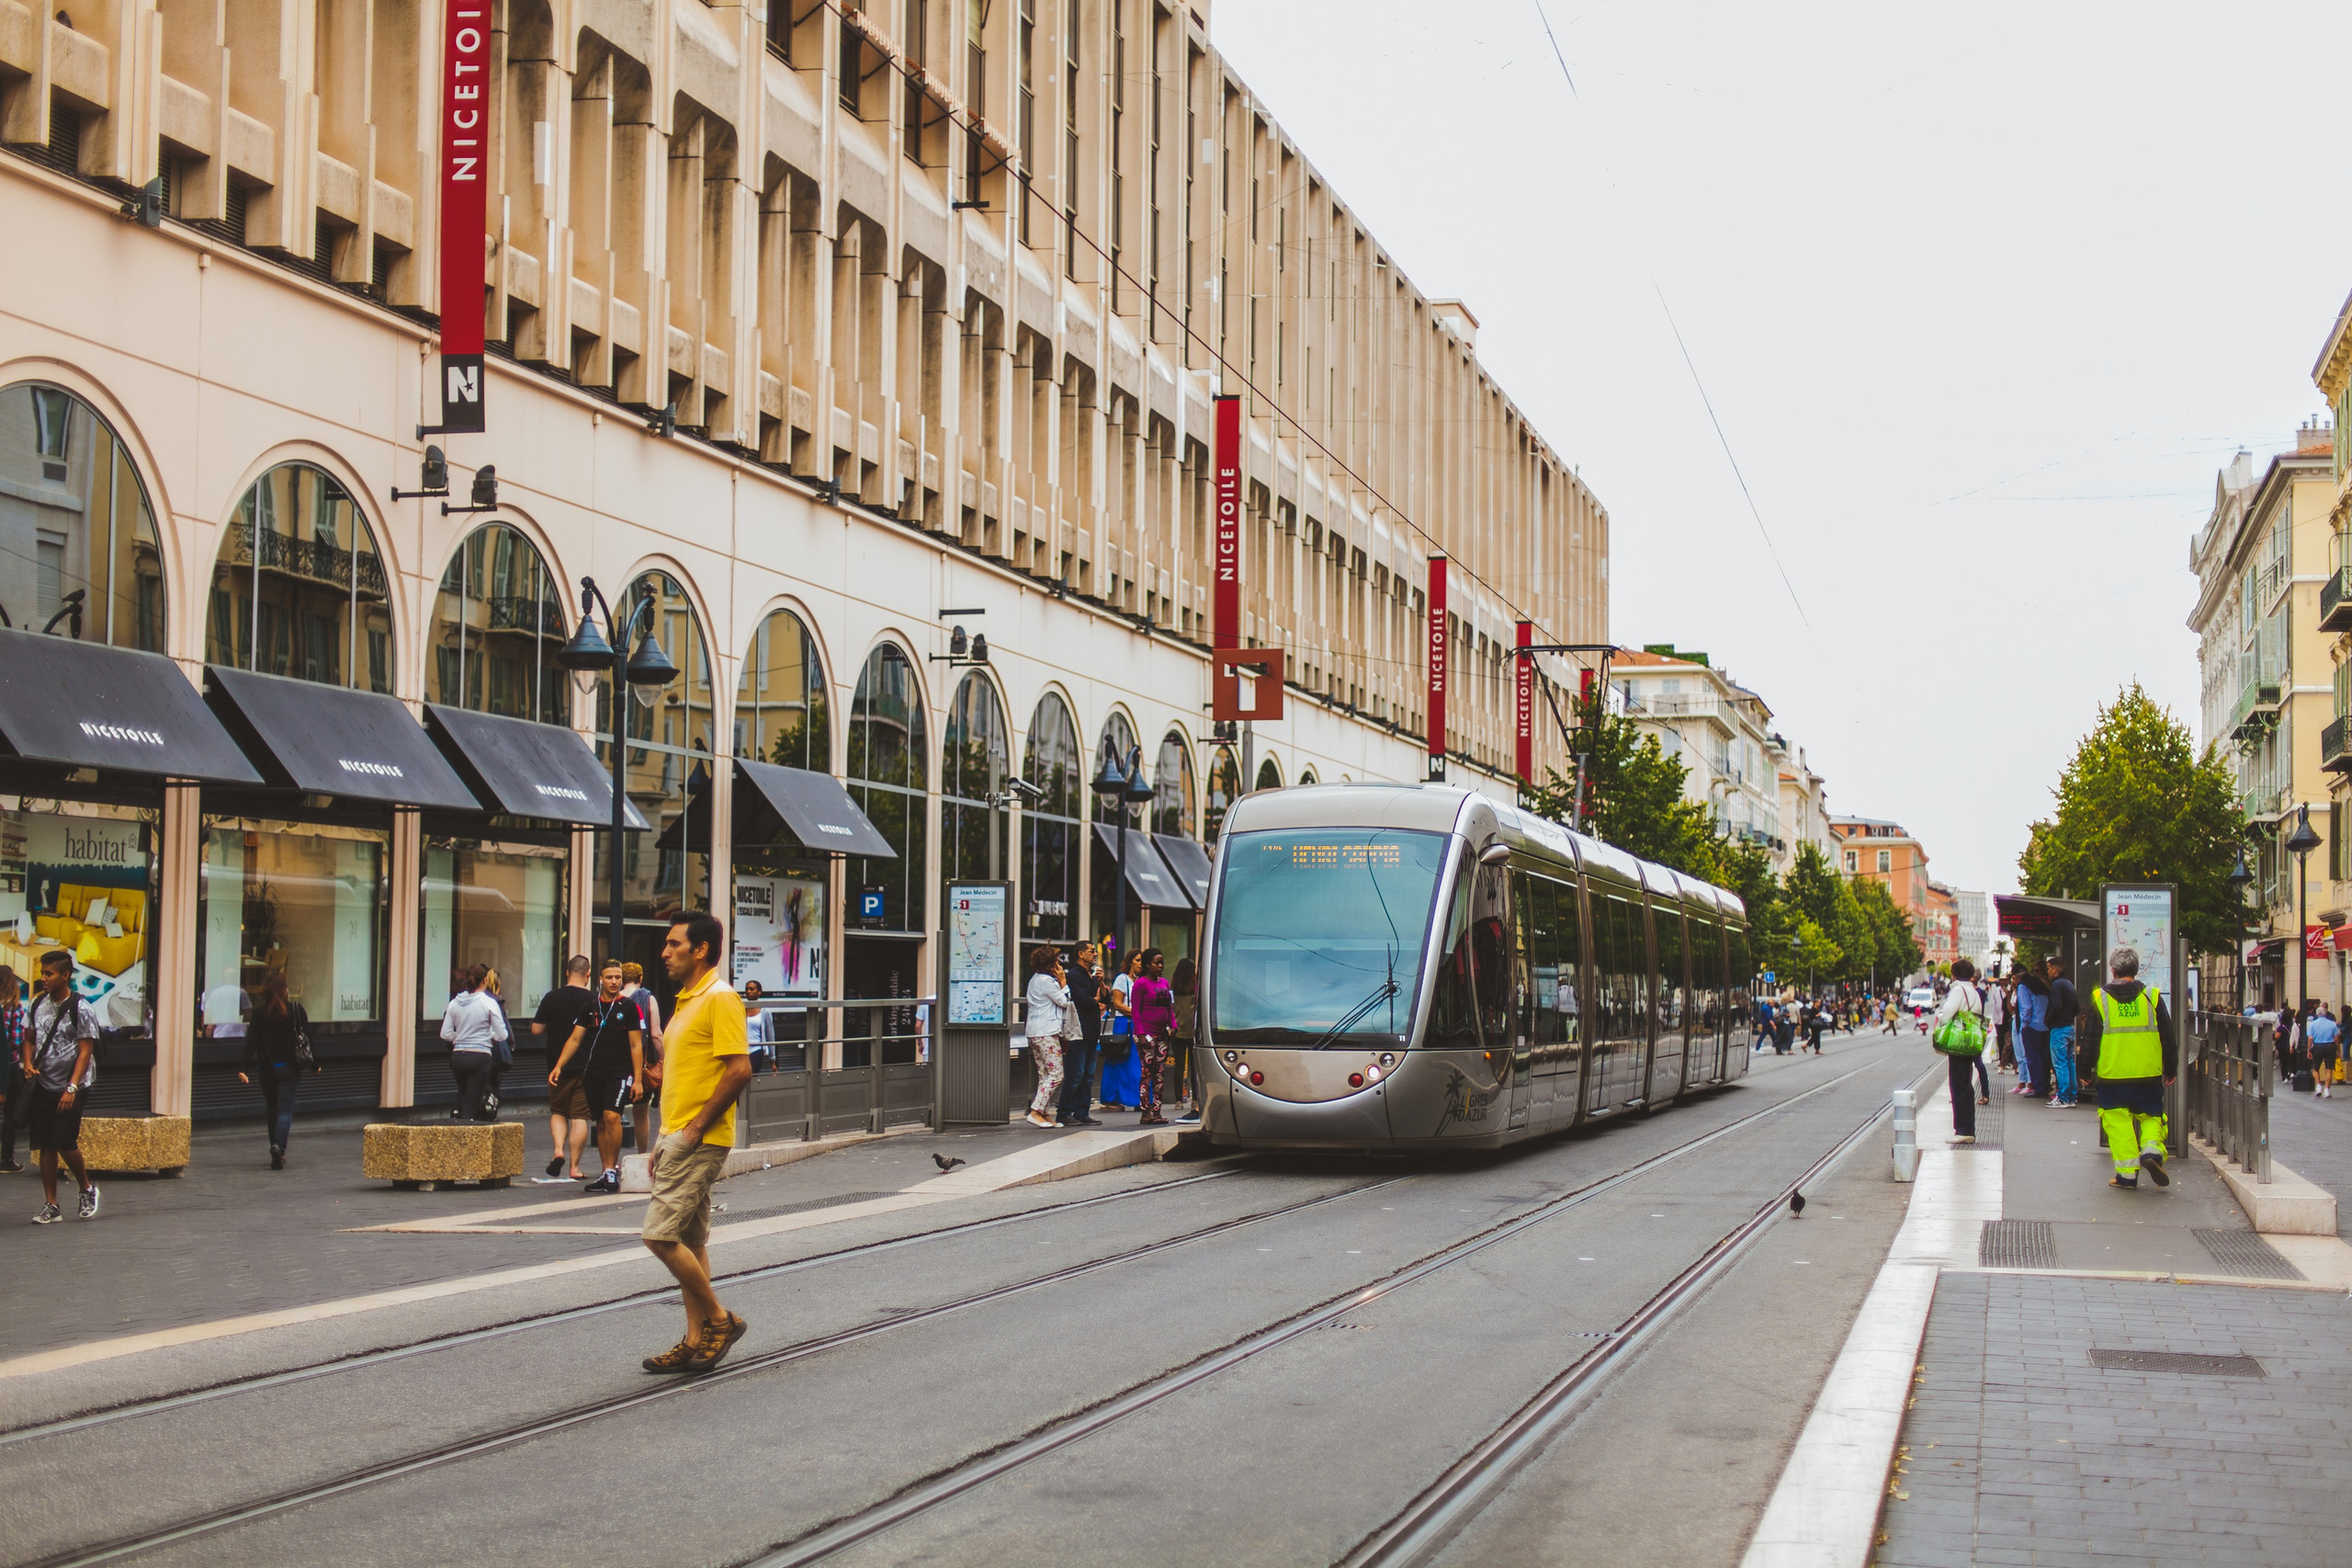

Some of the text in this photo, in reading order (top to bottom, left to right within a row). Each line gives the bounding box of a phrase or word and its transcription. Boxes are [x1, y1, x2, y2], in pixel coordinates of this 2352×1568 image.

[452, 8, 481, 180] NICETOI
[447, 366, 478, 402] N
[1220, 468, 1235, 581] NICETOILE
[1432, 608, 1443, 691] NICETOILE
[1224, 662, 1268, 711] T
[1520, 666, 1530, 738] NICETOILE
[79, 722, 164, 745] NICETOILE
[338, 759, 403, 777] NICETOILE
[1430, 758, 1443, 773] N
[535, 784, 587, 801] NICETOILE
[818, 823, 853, 836] NICETOILE
[64, 828, 127, 863] habitat
[737, 886, 771, 905] NICETOILE
[865, 897, 879, 914] P
[341, 994, 368, 1010] habitat
